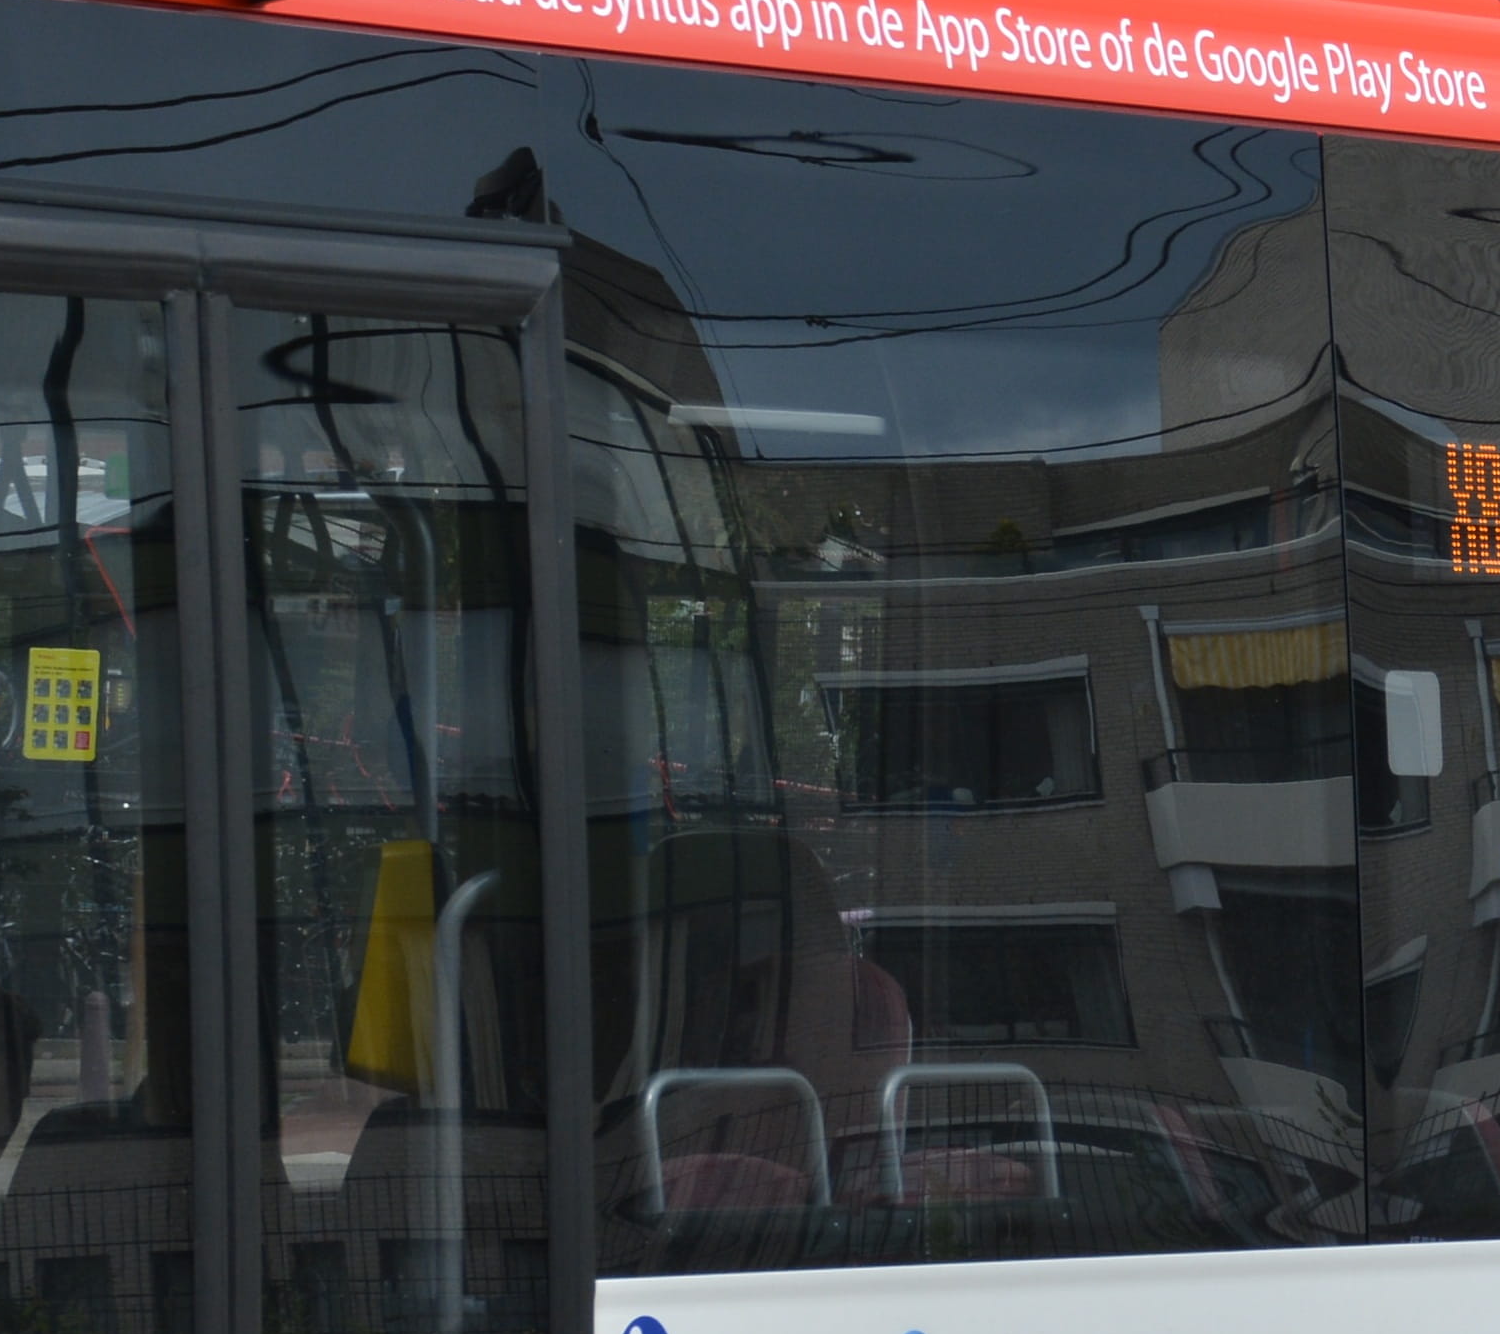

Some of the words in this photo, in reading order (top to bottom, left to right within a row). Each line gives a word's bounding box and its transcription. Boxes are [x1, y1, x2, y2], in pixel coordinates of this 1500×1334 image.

[995, 8, 1093, 69] Store
[1100, 18, 1135, 73] of
[1143, 22, 1188, 80] de
[1193, 29, 1321, 103] Google
[1323, 42, 1392, 114] Play
[1399, 51, 1488, 110] Store
